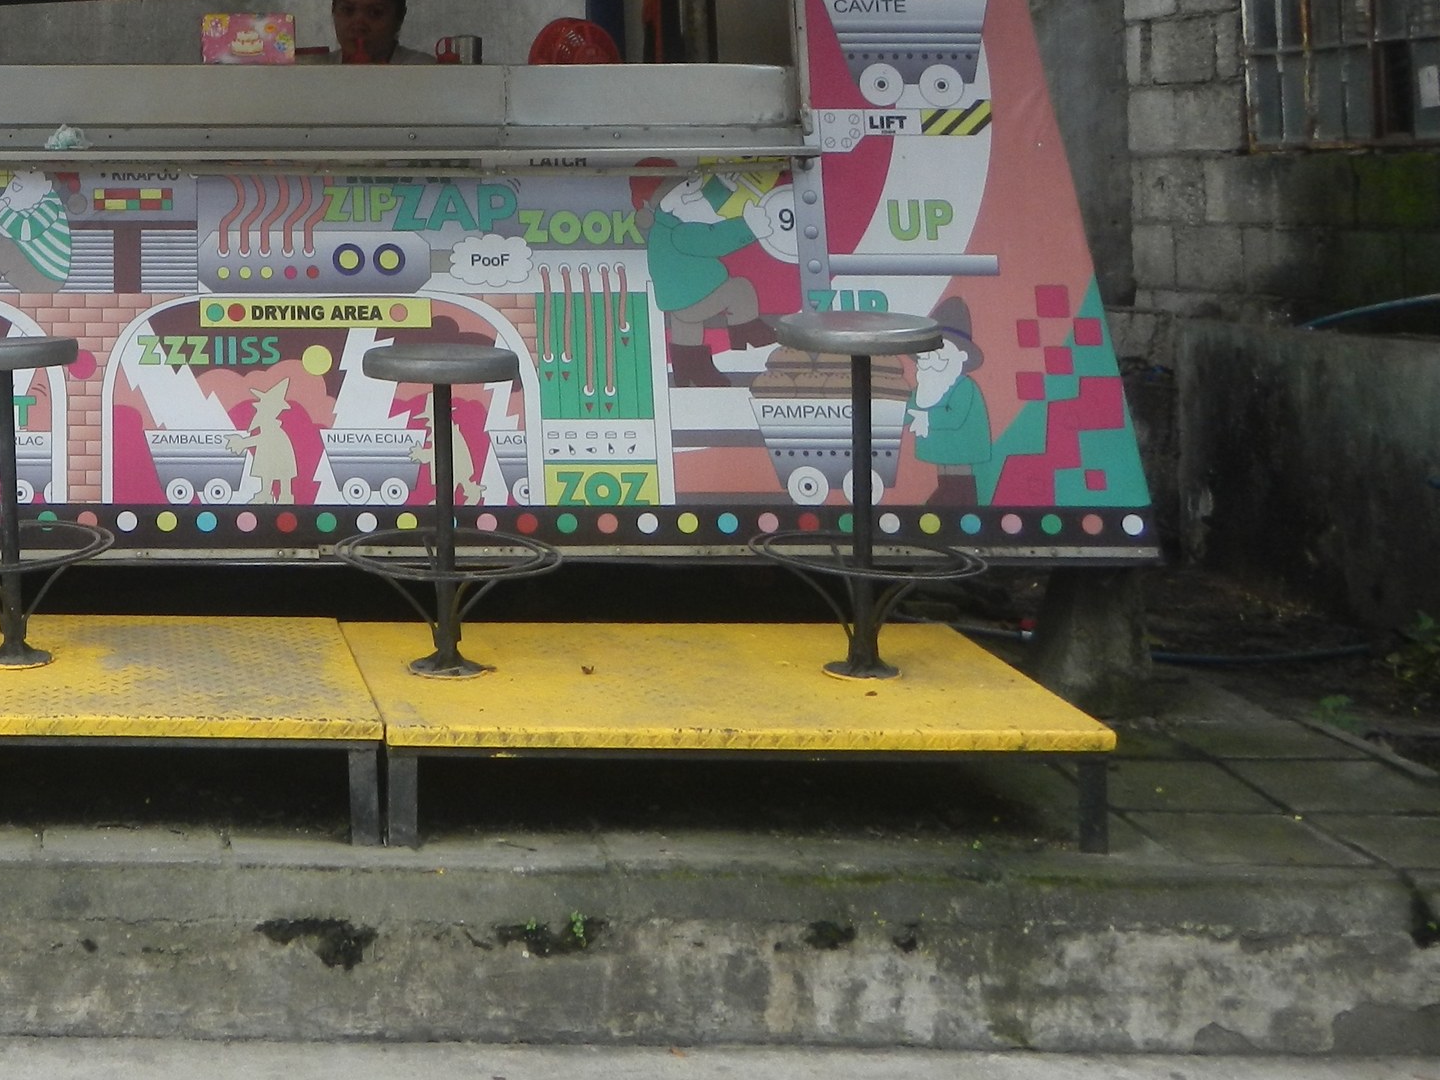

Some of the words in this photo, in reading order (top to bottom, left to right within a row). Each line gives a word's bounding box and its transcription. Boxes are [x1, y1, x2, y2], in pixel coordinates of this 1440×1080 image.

[833, 0, 907, 13] CAVITE
[869, 116, 907, 129] LIFT
[517, 210, 645, 245] ZOOK
[778, 209, 795, 231] 9
[887, 199, 954, 241] UP
[251, 305, 324, 320] DRYING
[330, 305, 383, 320] AREA
[151, 433, 223, 445] ZAMBALES
[326, 433, 371, 445] NUEVA
[375, 433, 413, 445] ECIJA
[556, 471, 651, 506] ZOZ
